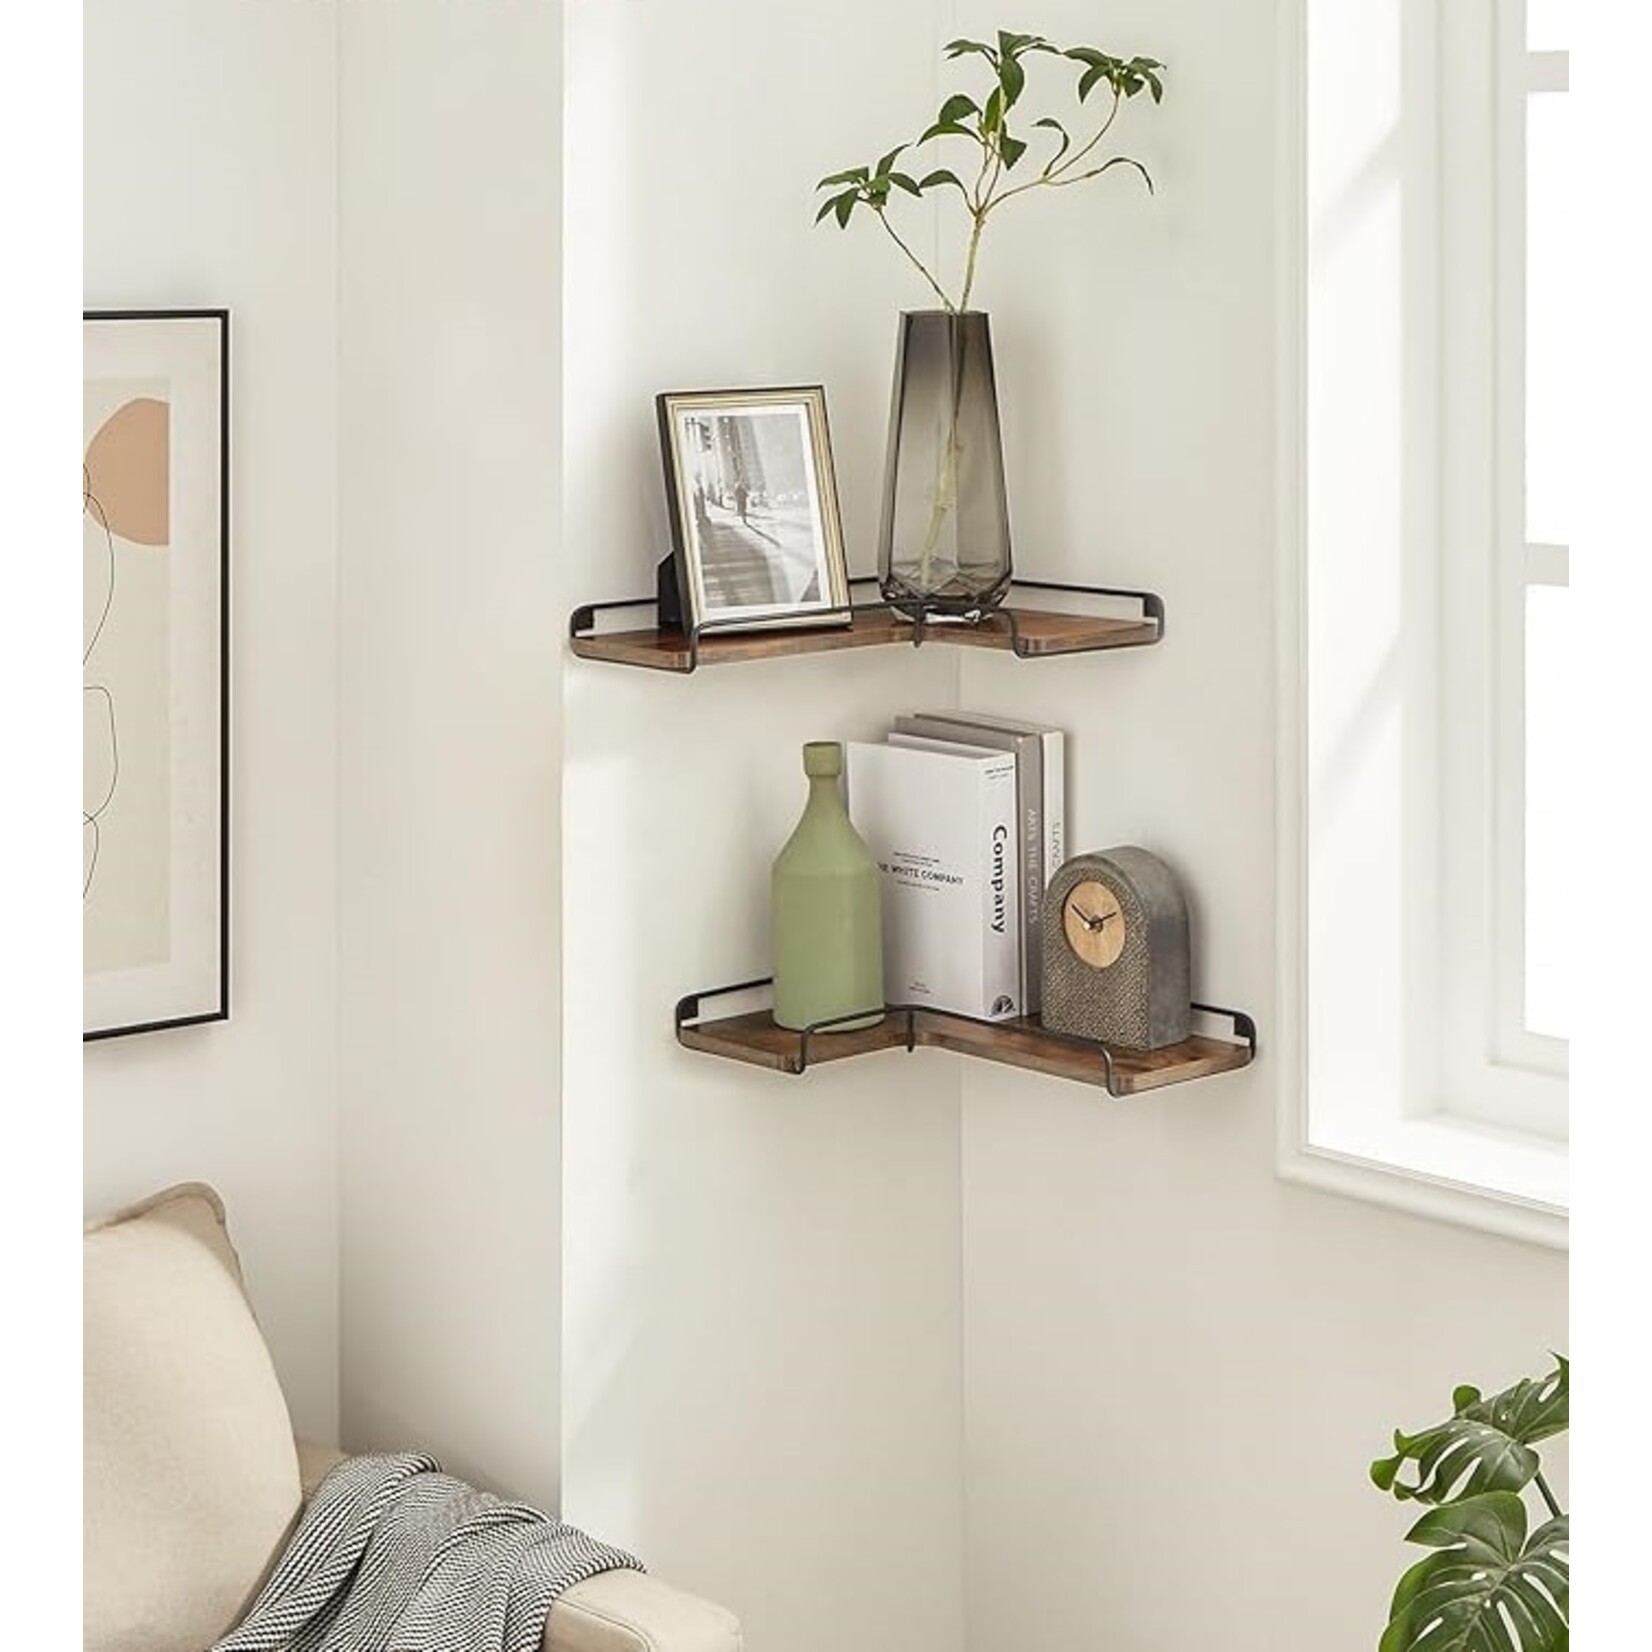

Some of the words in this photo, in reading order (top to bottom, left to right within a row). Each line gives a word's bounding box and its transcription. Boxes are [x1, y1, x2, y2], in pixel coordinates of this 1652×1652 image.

[890, 864, 919, 878] WHITE
[920, 869, 964, 885] COMPANY
[990, 824, 1007, 933] Company
